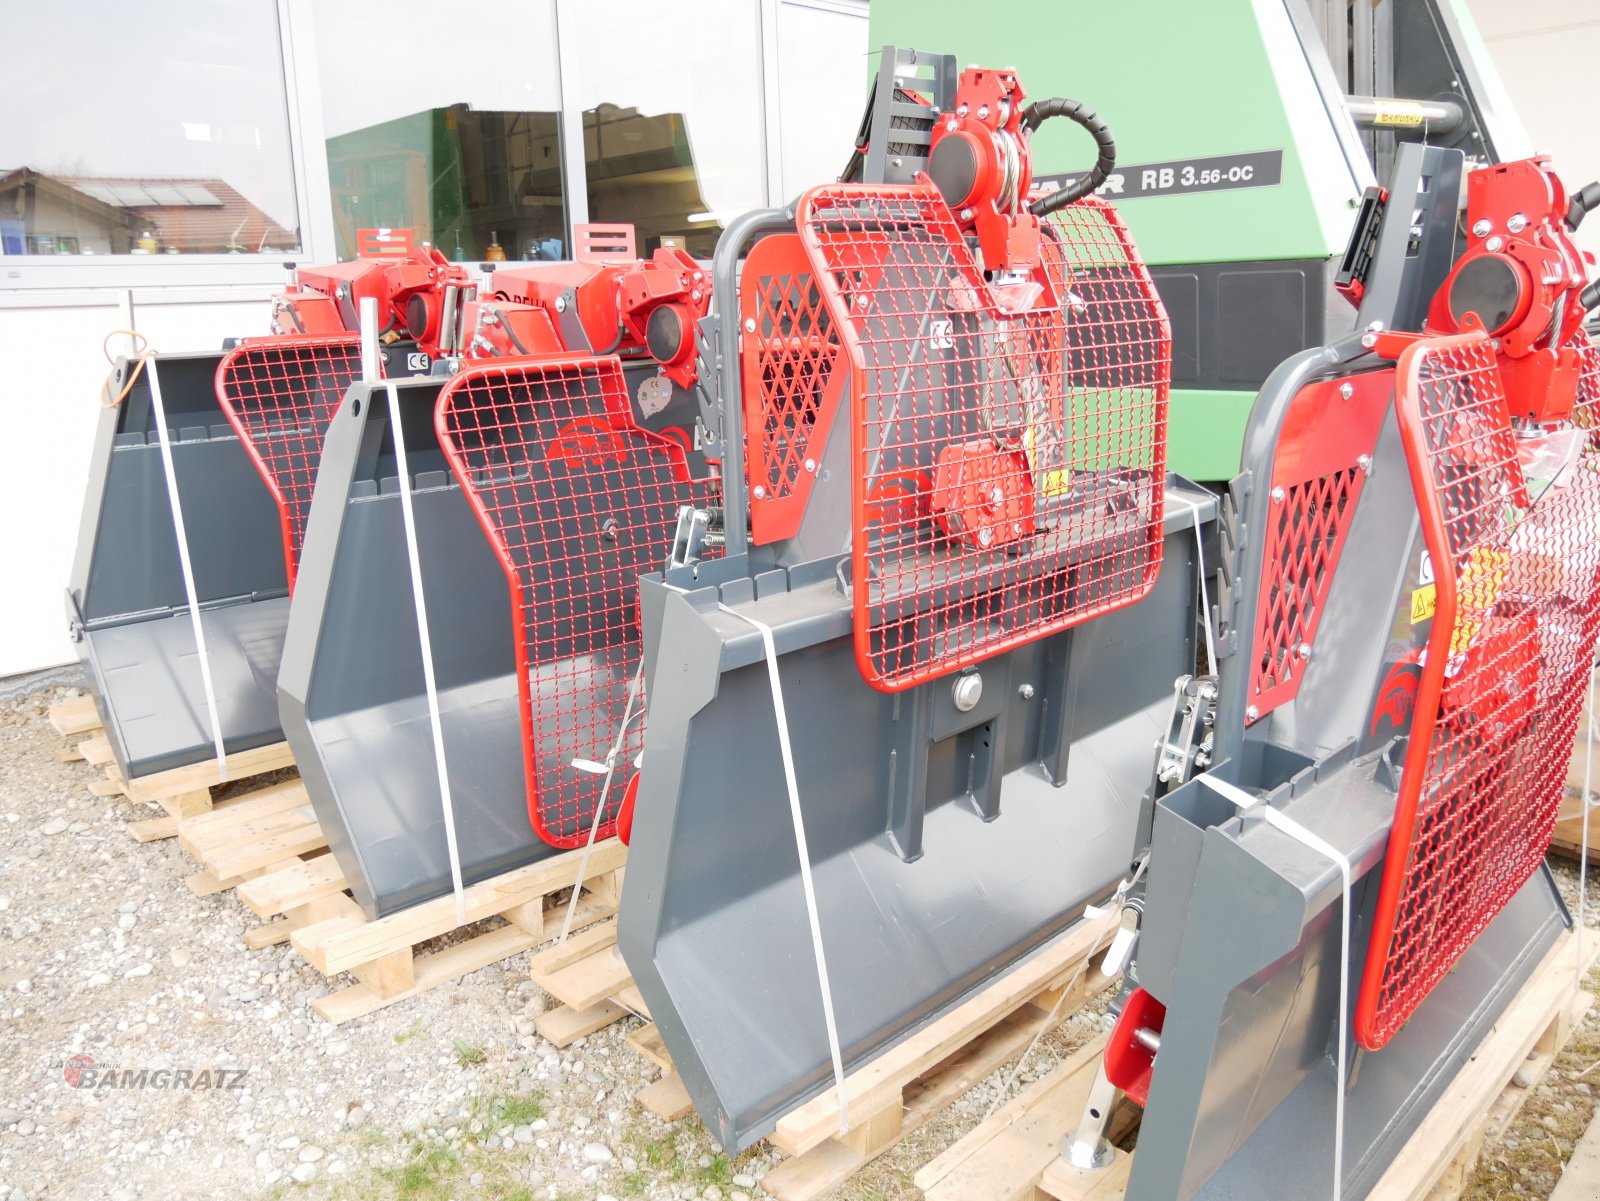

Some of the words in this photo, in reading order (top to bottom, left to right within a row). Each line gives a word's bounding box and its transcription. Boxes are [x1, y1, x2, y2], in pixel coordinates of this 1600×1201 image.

[1141, 168, 1175, 191] RB
[1181, 166, 1254, 186] 3.56-OC
[409, 354, 426, 369] CE
